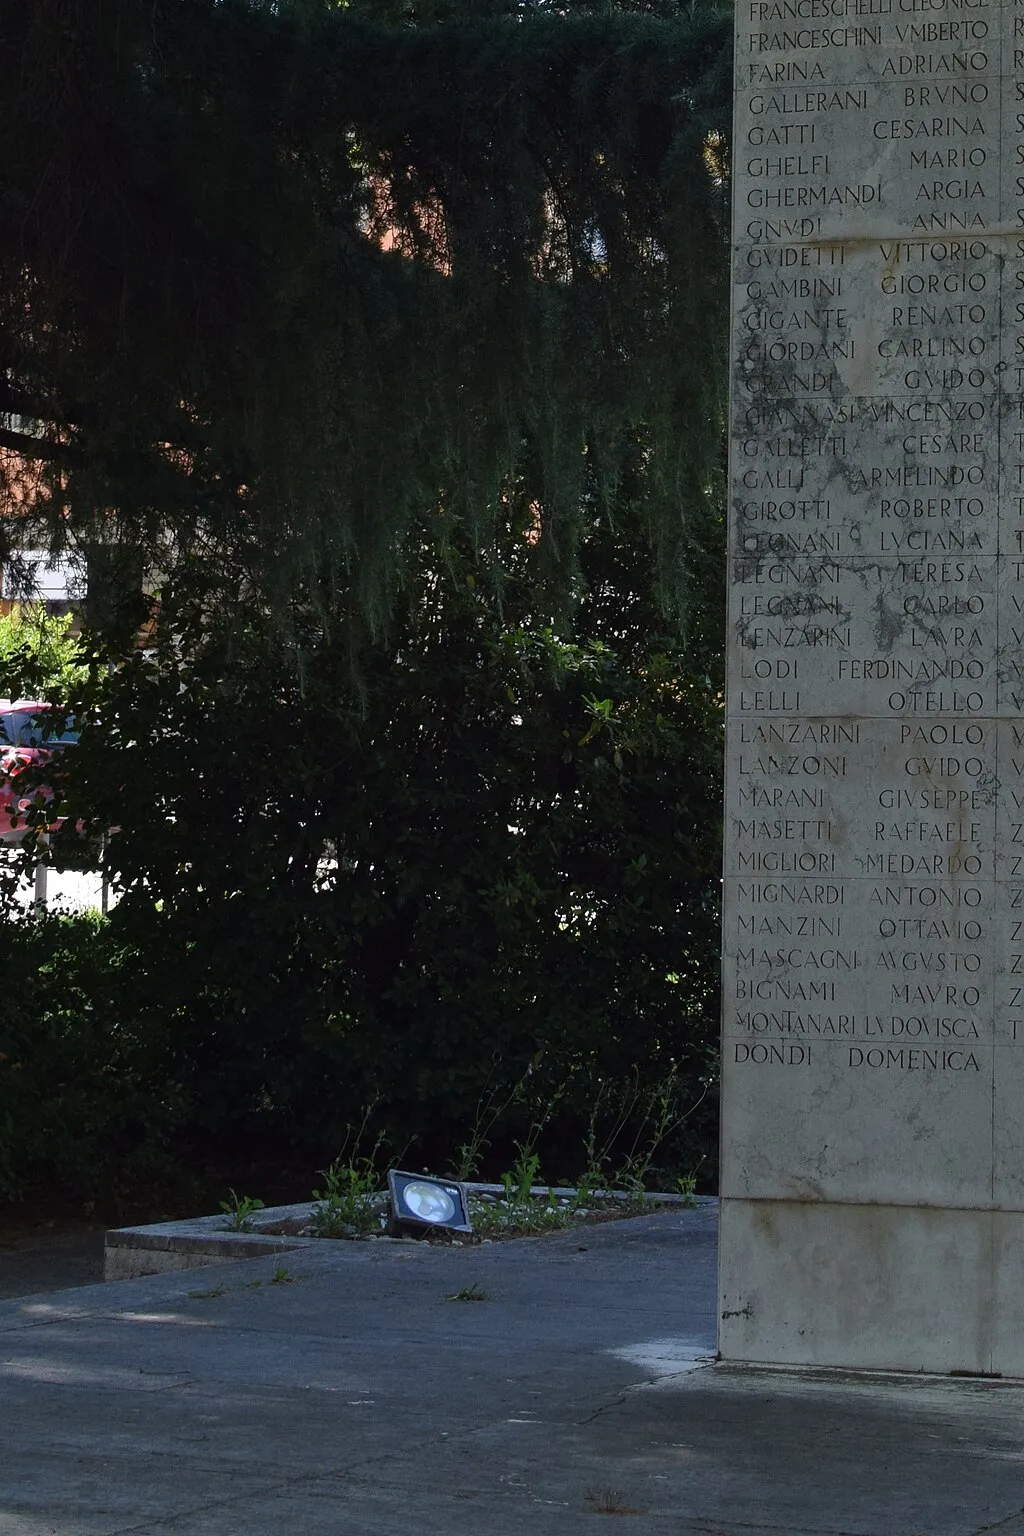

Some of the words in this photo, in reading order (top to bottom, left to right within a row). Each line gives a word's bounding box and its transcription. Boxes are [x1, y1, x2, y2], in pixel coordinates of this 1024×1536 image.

[749, 59, 825, 84] FARINA
[881, 50, 988, 77] ADRIANO
[749, 89, 867, 116] GALLERANI
[904, 83, 988, 108] BRVNO
[748, 124, 815, 147] GATTI
[873, 115, 985, 141] CESARINA
[747, 154, 828, 178] GHELFI
[910, 146, 986, 171] MARIO
[747, 182, 882, 209] GHERMANDI
[915, 179, 985, 202] ARGIA
[742, 501, 830, 523] GIROTTI
[880, 497, 984, 520] ROBERTO
[741, 659, 797, 680] LODI
[838, 658, 984, 680] FERDINANDO
[740, 691, 799, 711] LELLI
[887, 691, 984, 712] OTELLO
[740, 725, 859, 744] LANZARINI
[900, 724, 983, 745] PAOLO
[739, 756, 846, 776] LANZONI
[905, 756, 982, 776] GVIDO
[738, 789, 823, 808] MARANI
[878, 790, 981, 810] GIVSEPPE
[738, 885, 844, 906] MIGNARDI
[869, 886, 981, 908] ANTONIO
[734, 1044, 811, 1067] DONDI
[848, 1048, 979, 1072] DOMENICA
